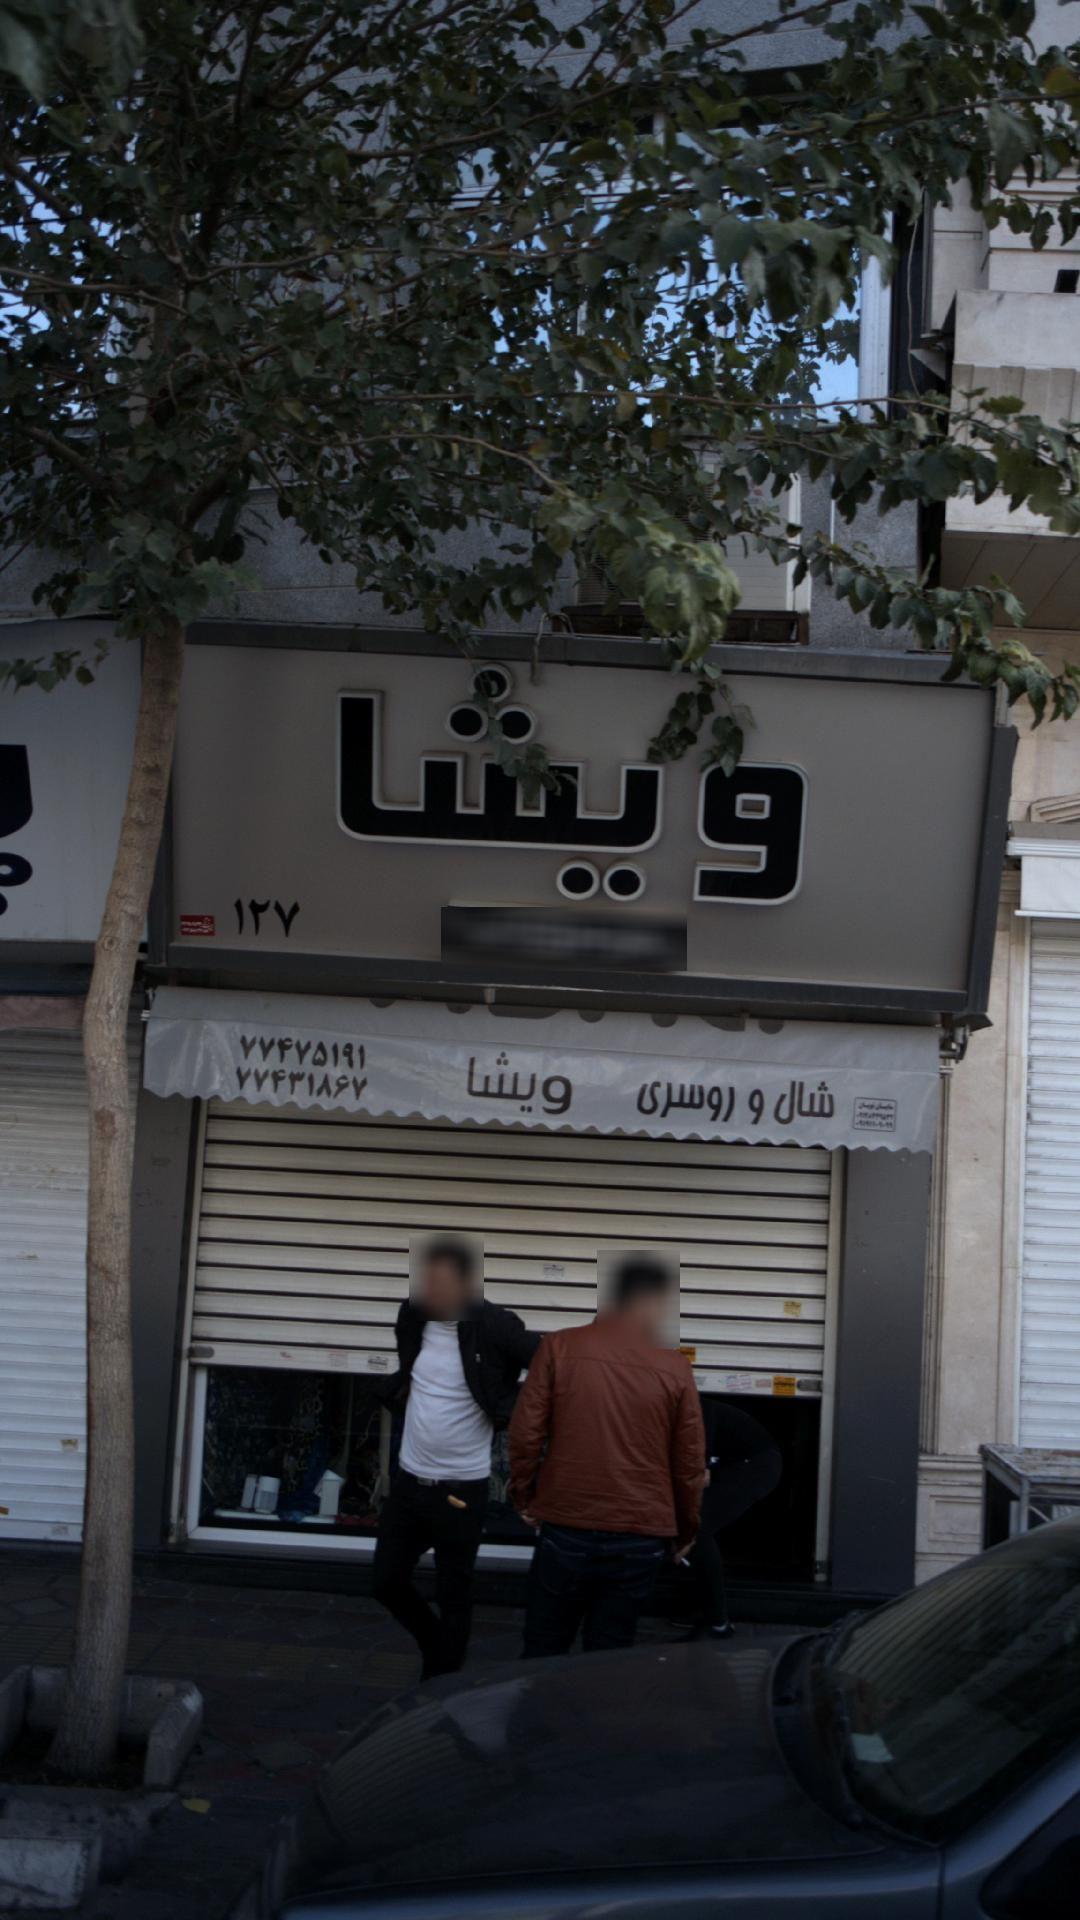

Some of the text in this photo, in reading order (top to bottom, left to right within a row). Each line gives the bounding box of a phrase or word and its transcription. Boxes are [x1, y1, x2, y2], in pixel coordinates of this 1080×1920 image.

[337, 662, 808, 906] ویشا
[234, 898, 300, 938] ۱۲۷
[239, 1034, 366, 1070] ۷۷۴۷۵۱۹۱
[236, 1066, 368, 1101] ۷۷۴۳۱۸۶۷
[467, 1051, 573, 1115] ویشا
[637, 1080, 835, 1126] شال و روسری
